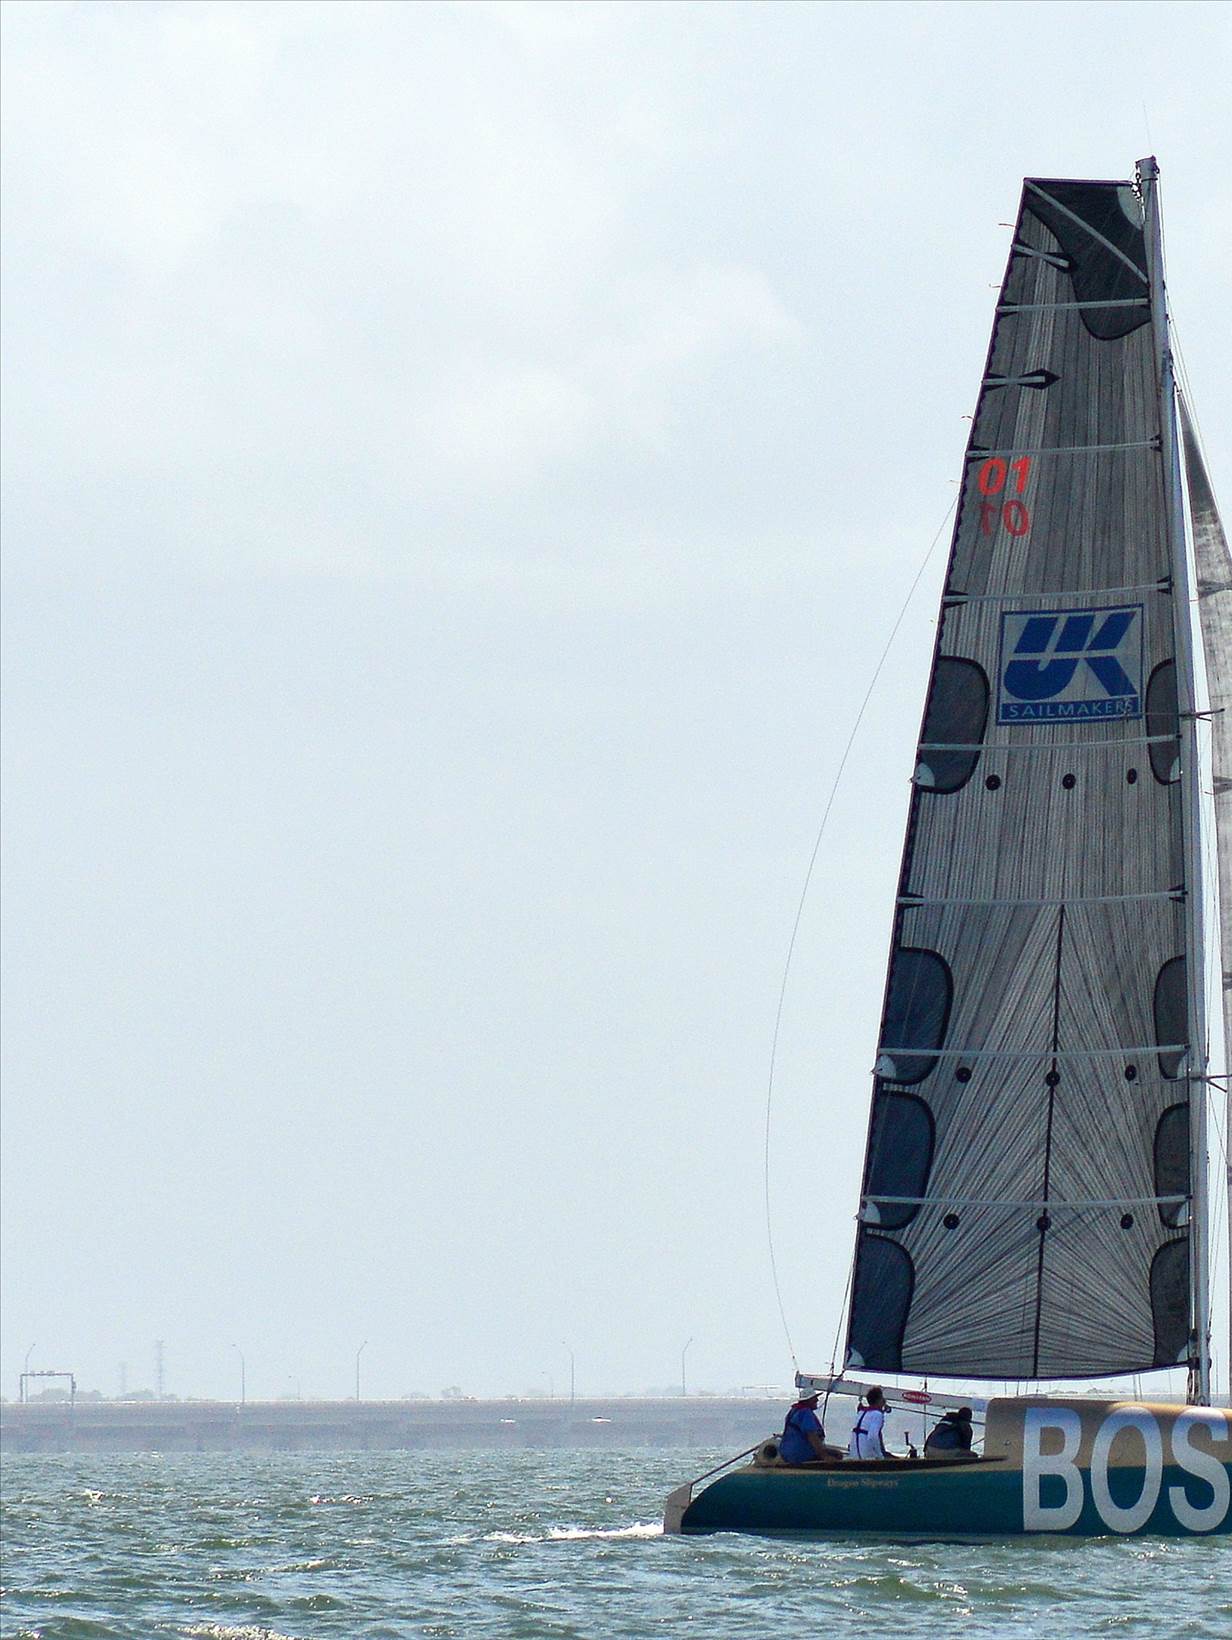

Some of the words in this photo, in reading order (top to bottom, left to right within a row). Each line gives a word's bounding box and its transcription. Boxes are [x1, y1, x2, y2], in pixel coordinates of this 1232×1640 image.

[978, 455, 1031, 495] 01
[1003, 611, 1137, 700] UK
[1009, 701, 1133, 717] SAILMAKERS
